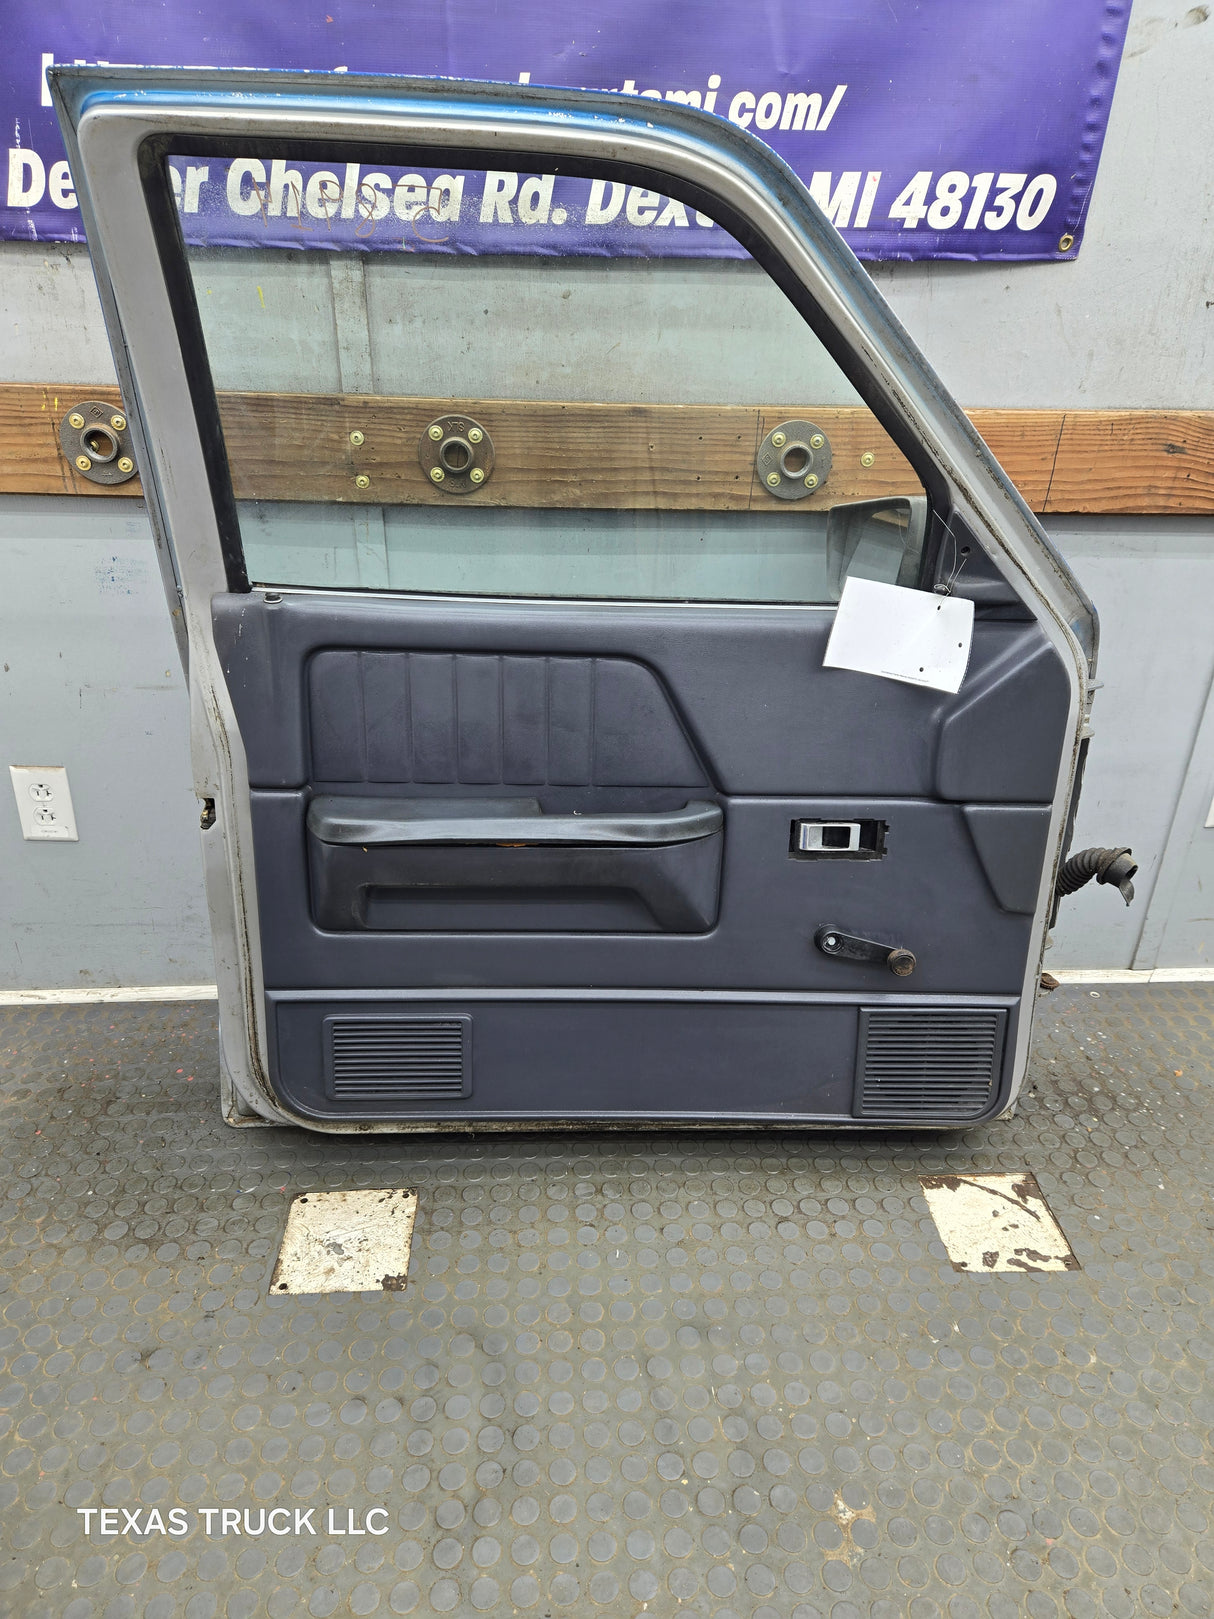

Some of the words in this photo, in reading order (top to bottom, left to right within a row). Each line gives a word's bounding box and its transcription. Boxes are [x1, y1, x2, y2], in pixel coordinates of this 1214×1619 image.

[226, 158, 465, 221] Chelsea
[479, 171, 567, 225] Rd.
[808, 171, 882, 228] MI
[888, 171, 1057, 231] 48130
